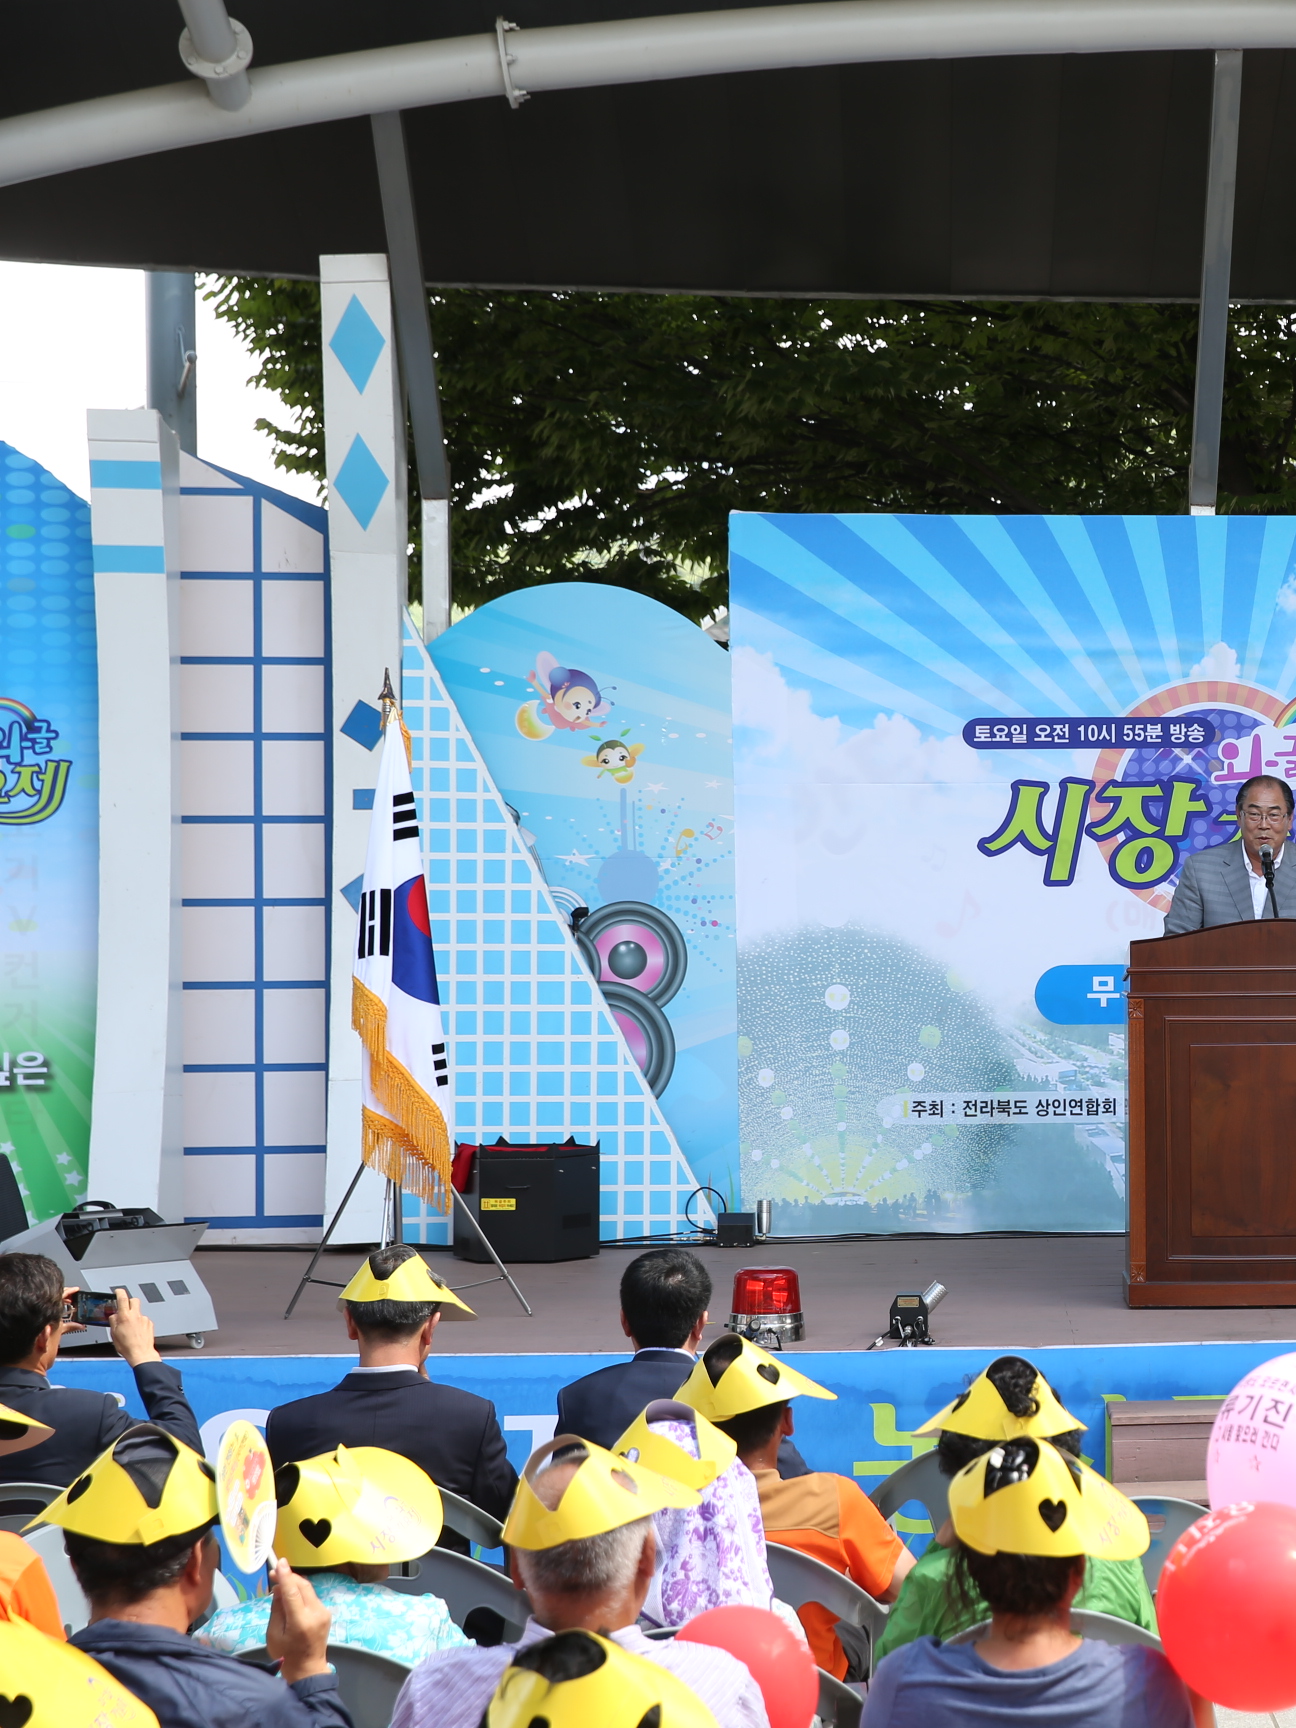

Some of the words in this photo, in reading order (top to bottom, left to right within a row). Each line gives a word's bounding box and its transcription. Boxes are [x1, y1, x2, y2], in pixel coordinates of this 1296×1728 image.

[973, 723, 1027, 744] 토요일
[1033, 723, 1070, 743] 오전
[1077, 723, 1116, 743] 10시
[1123, 723, 1163, 743] 55분
[1169, 723, 1205, 743] 방송
[1086, 976, 1126, 1008] 무
[911, 1099, 944, 1119] 주최
[962, 1099, 1029, 1118] 전라북도
[1035, 1097, 1118, 1117] 상인연합회
